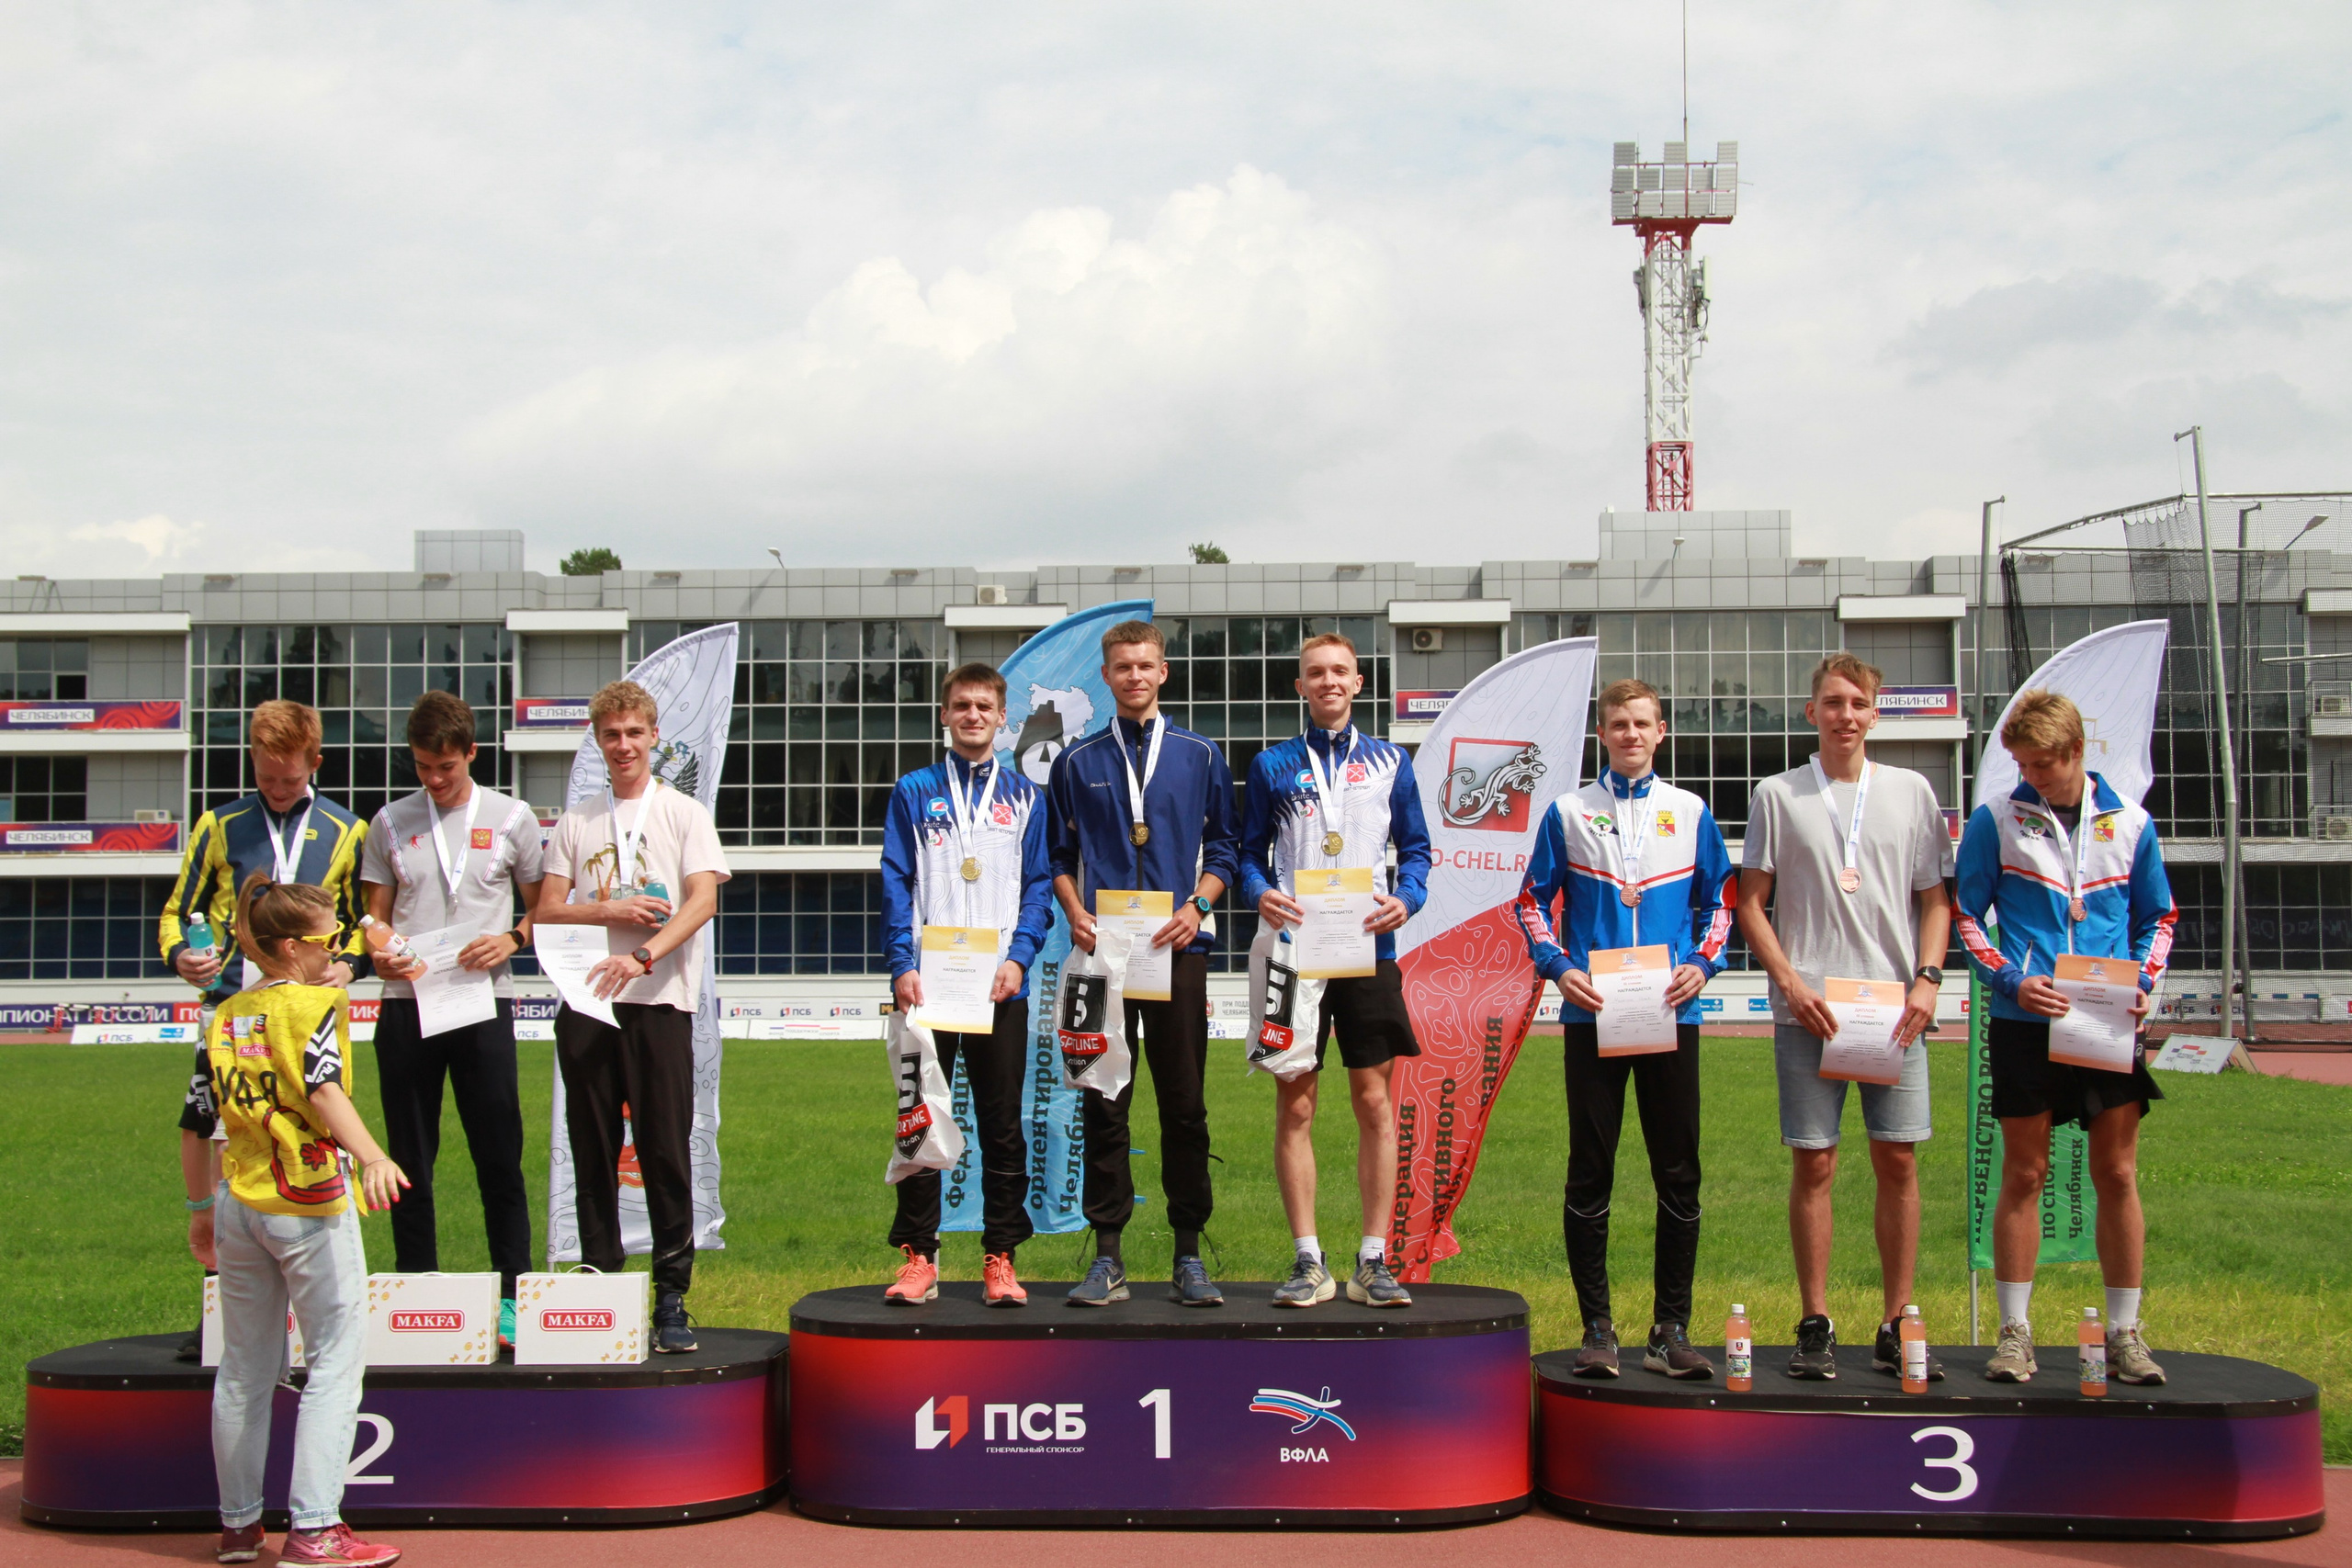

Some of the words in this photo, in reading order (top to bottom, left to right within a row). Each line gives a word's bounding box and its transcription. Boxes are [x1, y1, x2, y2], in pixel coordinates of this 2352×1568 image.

[11, 710, 91, 720] ЧЕЛЯБИНСК
[9, 831, 89, 841] ЧЕЛЯБИНСК
[2077, 998, 2113, 1006] НАГРАЖДАЕТСЯ
[742, 1008, 762, 1016] ПСБ
[792, 1008, 811, 1016] ПСБ
[842, 1008, 862, 1016] ПСБ
[1030, 961, 1059, 1211] ориентирования
[2065, 1138, 2083, 1239] Челябинск
[397, 1315, 457, 1326] MAKFA
[548, 1314, 607, 1326] MAKFA
[984, 1403, 1087, 1441] ПСБ
[1138, 1389, 1171, 1459] 1
[344, 1413, 394, 1484] 2
[1280, 1447, 1329, 1463] ВФЛА
[1910, 1426, 1978, 1501] 3
